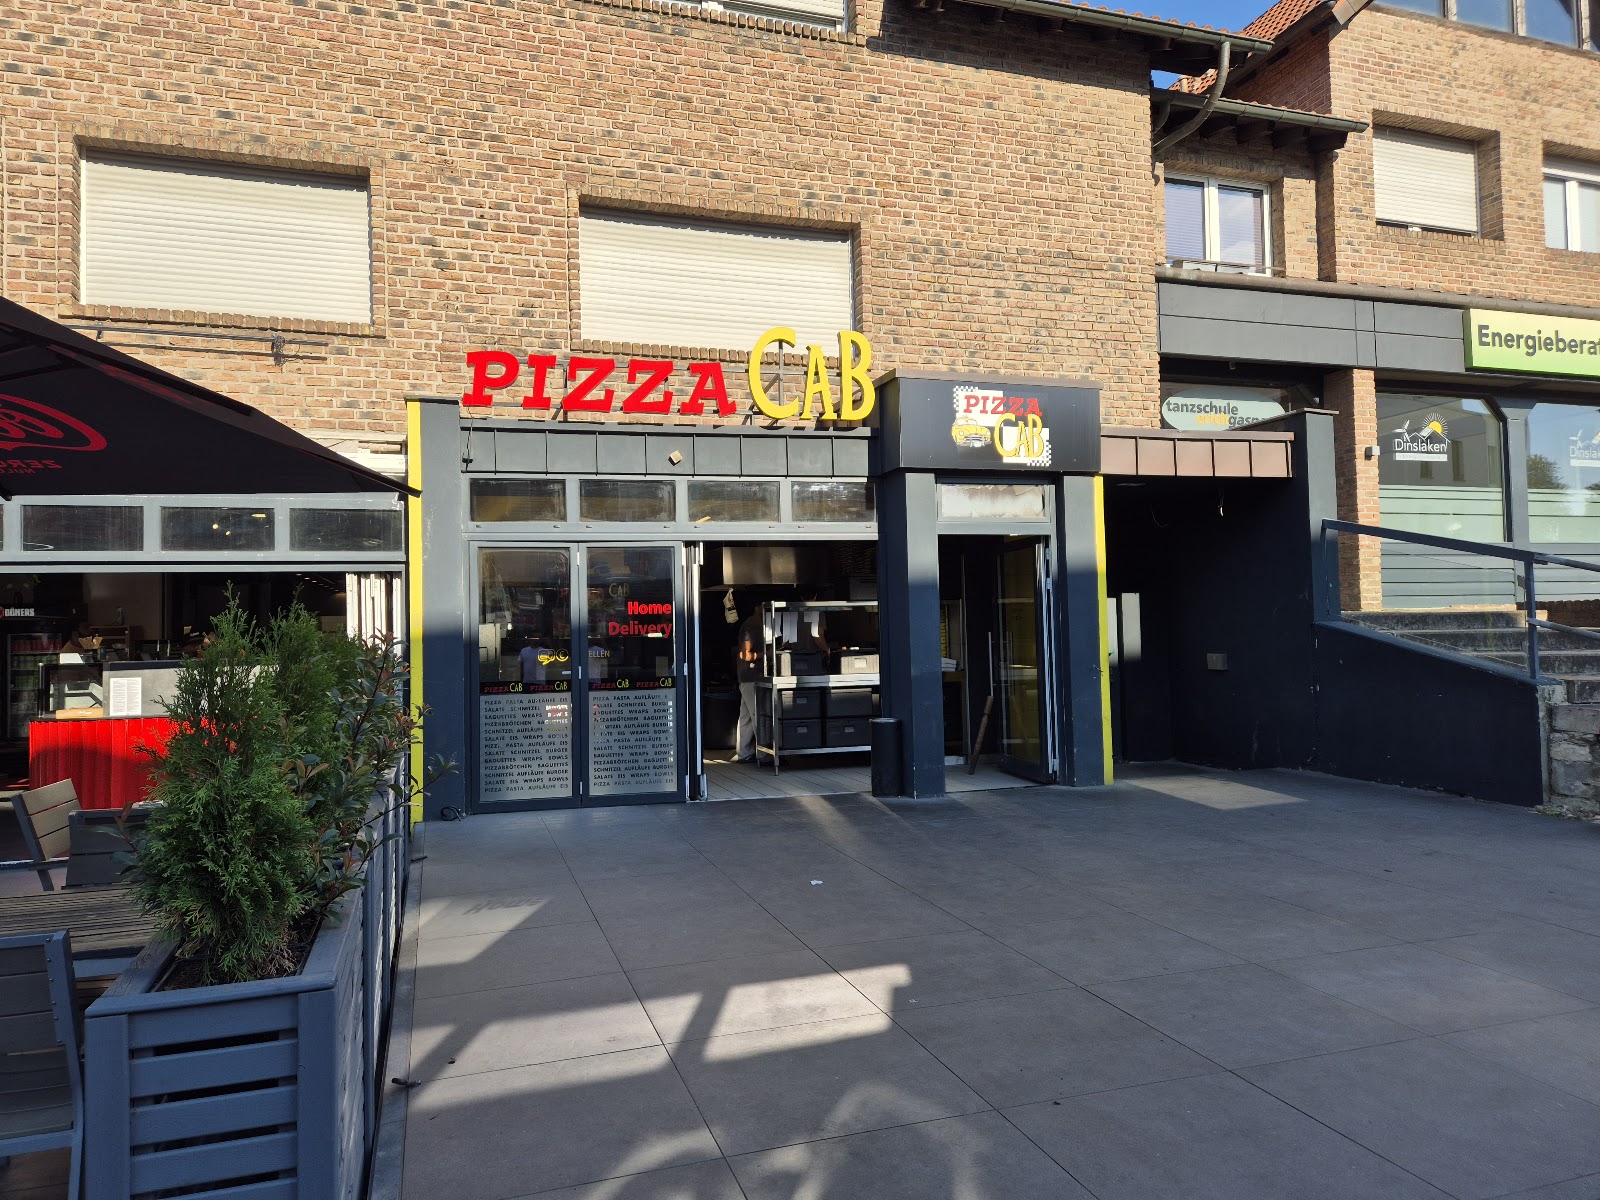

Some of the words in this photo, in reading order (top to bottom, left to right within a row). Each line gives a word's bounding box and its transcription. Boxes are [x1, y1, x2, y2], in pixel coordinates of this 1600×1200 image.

[462, 350, 737, 416] PIZZA
[748, 326, 876, 421] CAB
[963, 394, 1042, 416] PIZZA
[1166, 400, 1238, 415] tanzschule
[994, 412, 1044, 458] CAB
[1395, 438, 1447, 452] Dinslaken
[608, 582, 630, 598] CAB
[628, 601, 672, 615] Home
[608, 621, 672, 638] Delivery
[510, 683, 522, 692] CAB
[555, 682, 567, 691] CAB
[617, 679, 629, 688] CAB
[660, 678, 672, 686] CAB
